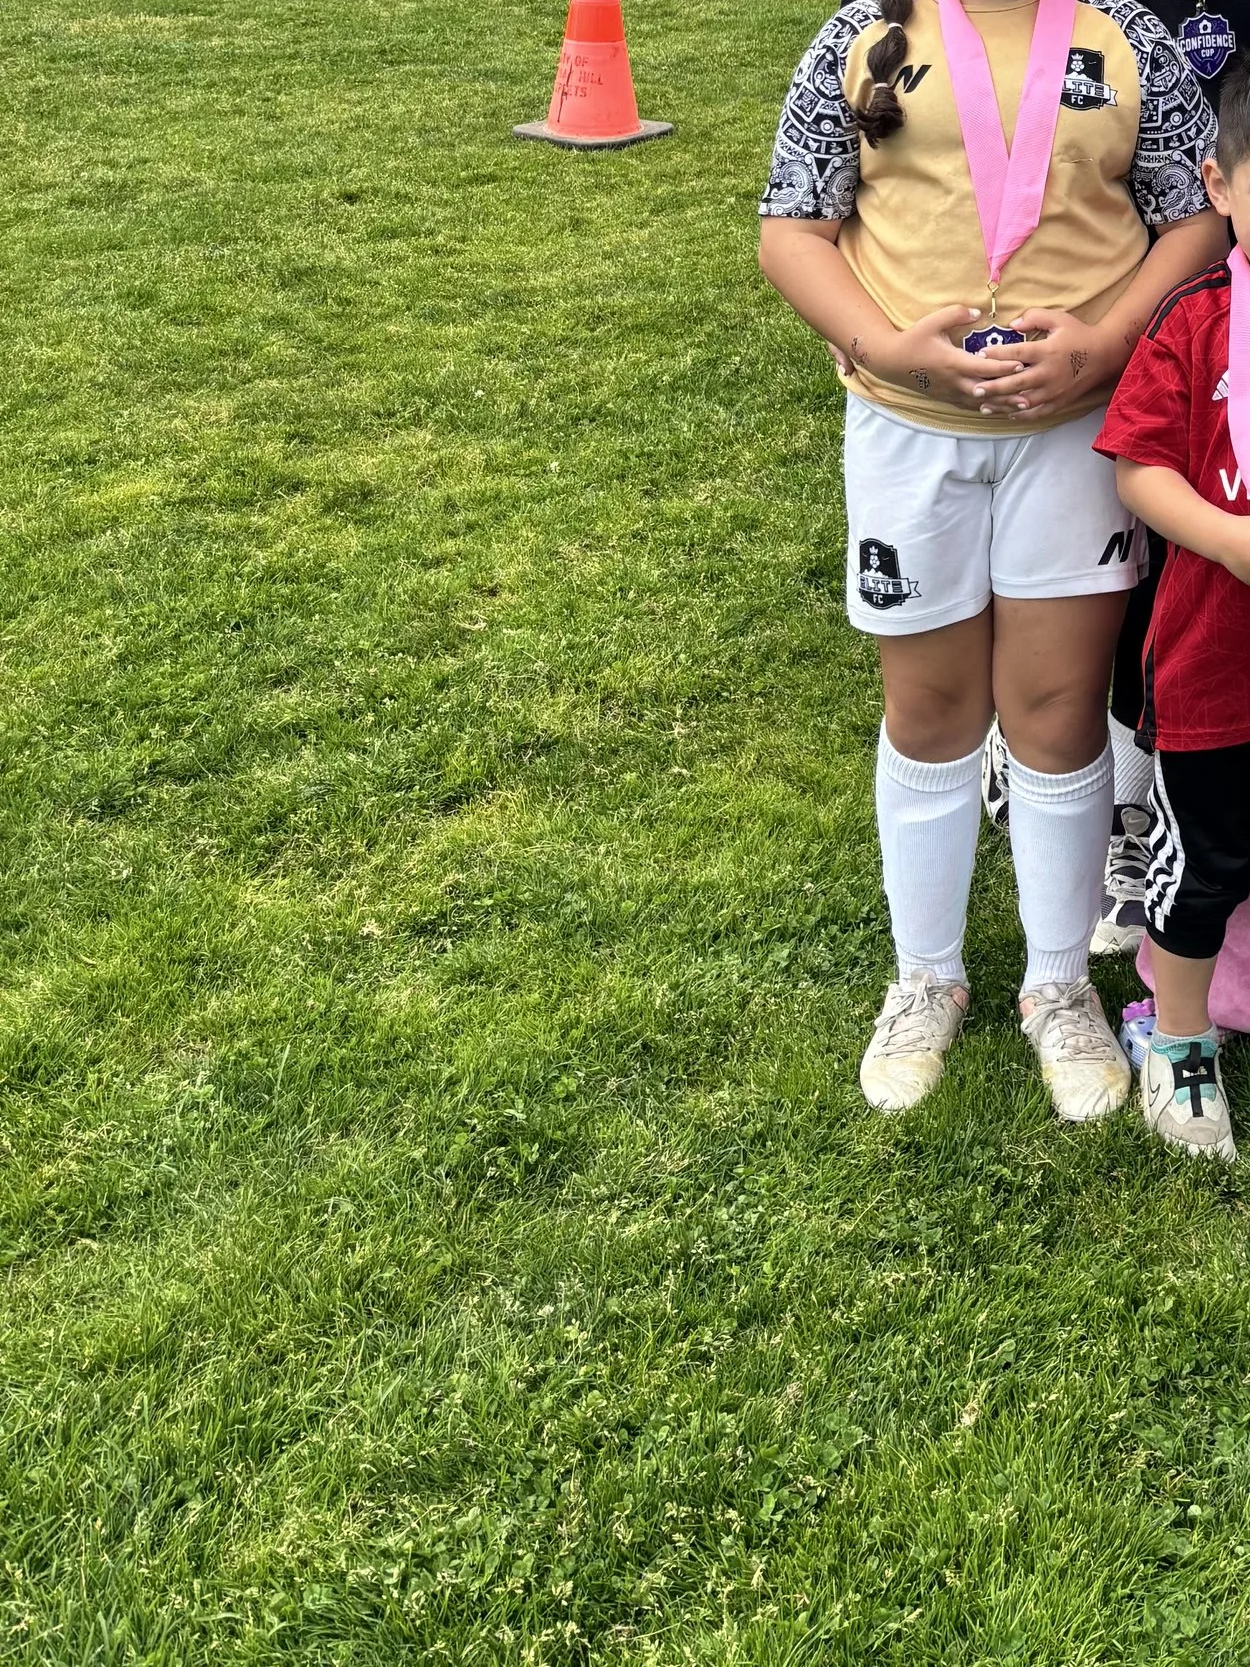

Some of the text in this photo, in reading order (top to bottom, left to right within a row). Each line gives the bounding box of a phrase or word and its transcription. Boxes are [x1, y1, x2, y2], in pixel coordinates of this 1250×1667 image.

[1180, 34, 1233, 53] CONFIDENCE
[1201, 48, 1215, 58] CUP
[575, 55, 589, 67] OF
[579, 70, 603, 86] HILL
[1062, 79, 1105, 98] LITE
[1071, 95, 1084, 105] FC
[860, 575, 903, 594] ELITE
[872, 594, 884, 604] FC
